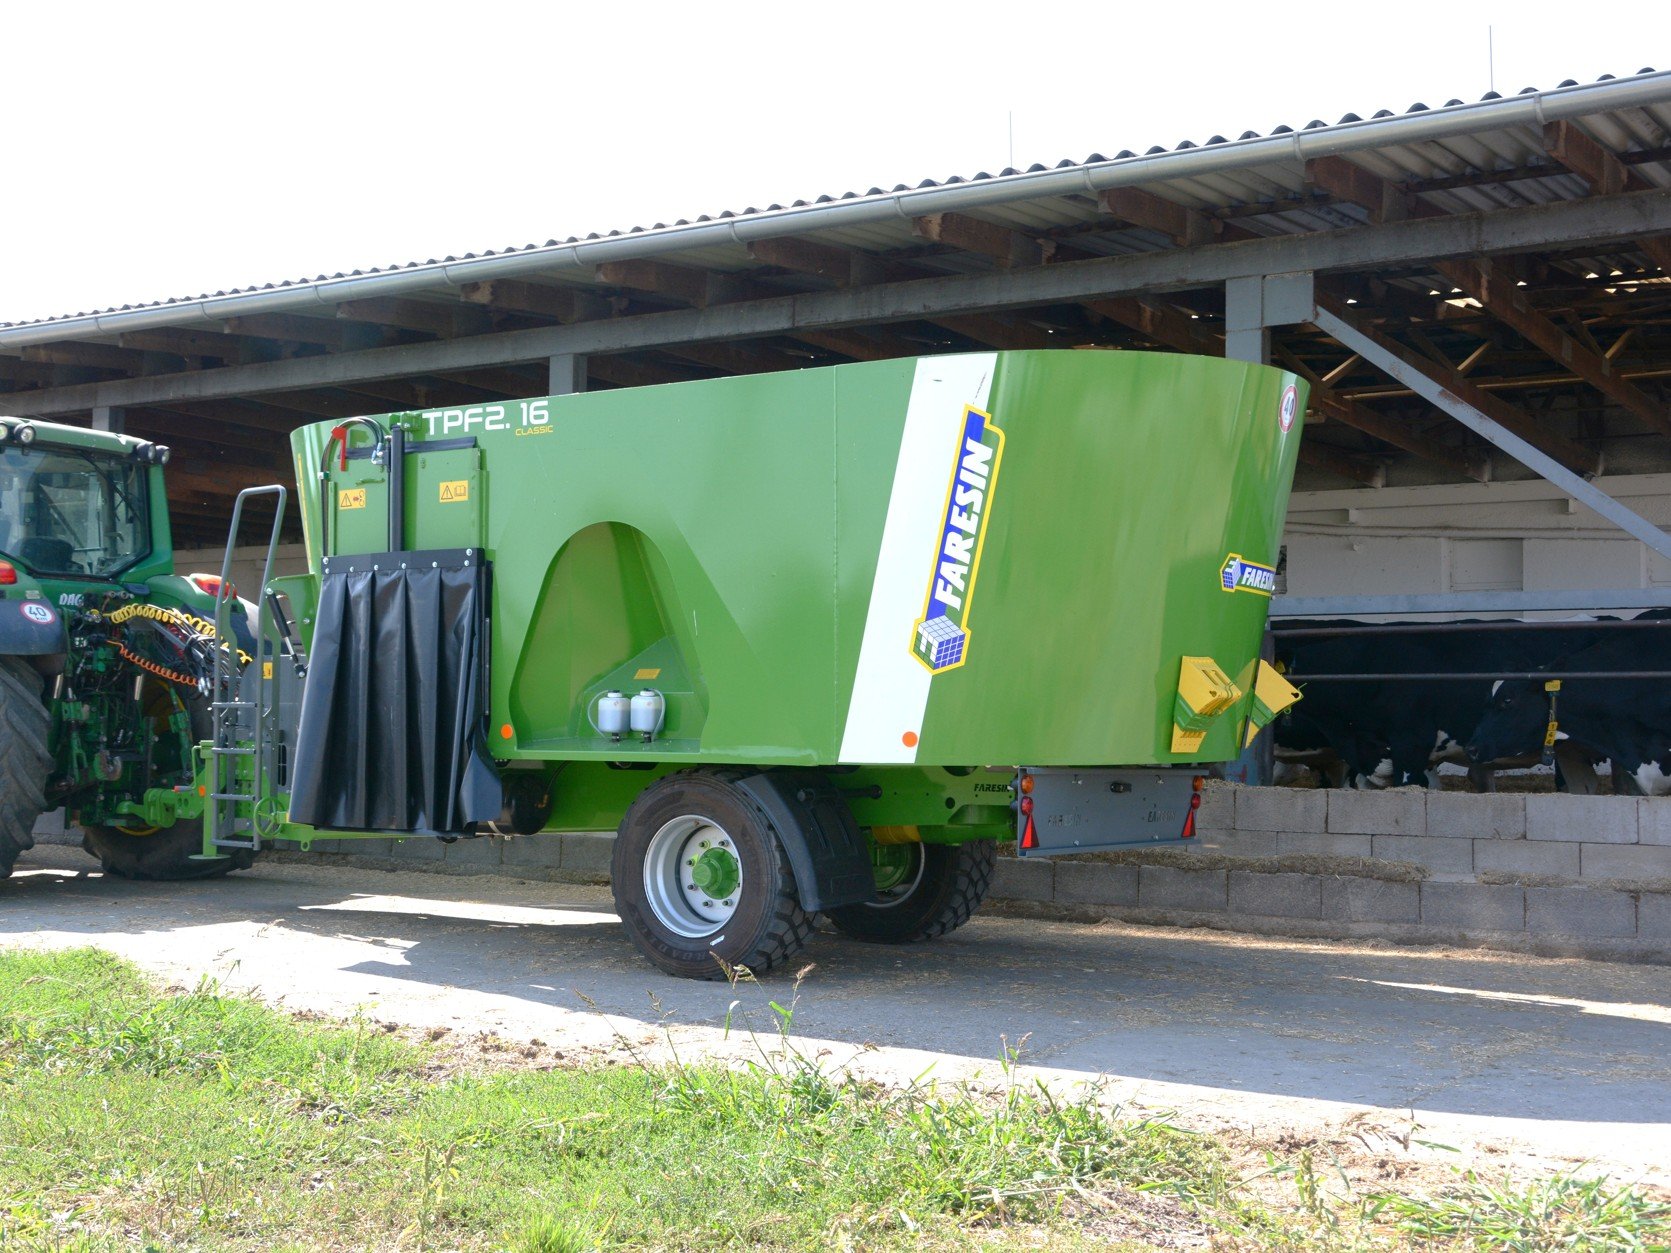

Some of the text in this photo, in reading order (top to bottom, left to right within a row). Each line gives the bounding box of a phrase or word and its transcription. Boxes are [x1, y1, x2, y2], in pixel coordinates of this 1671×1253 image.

[422, 400, 549, 435] TPF2. 16
[515, 425, 554, 436] CLASSIC
[934, 436, 993, 611] FARESIN
[29, 606, 47, 617] 40
